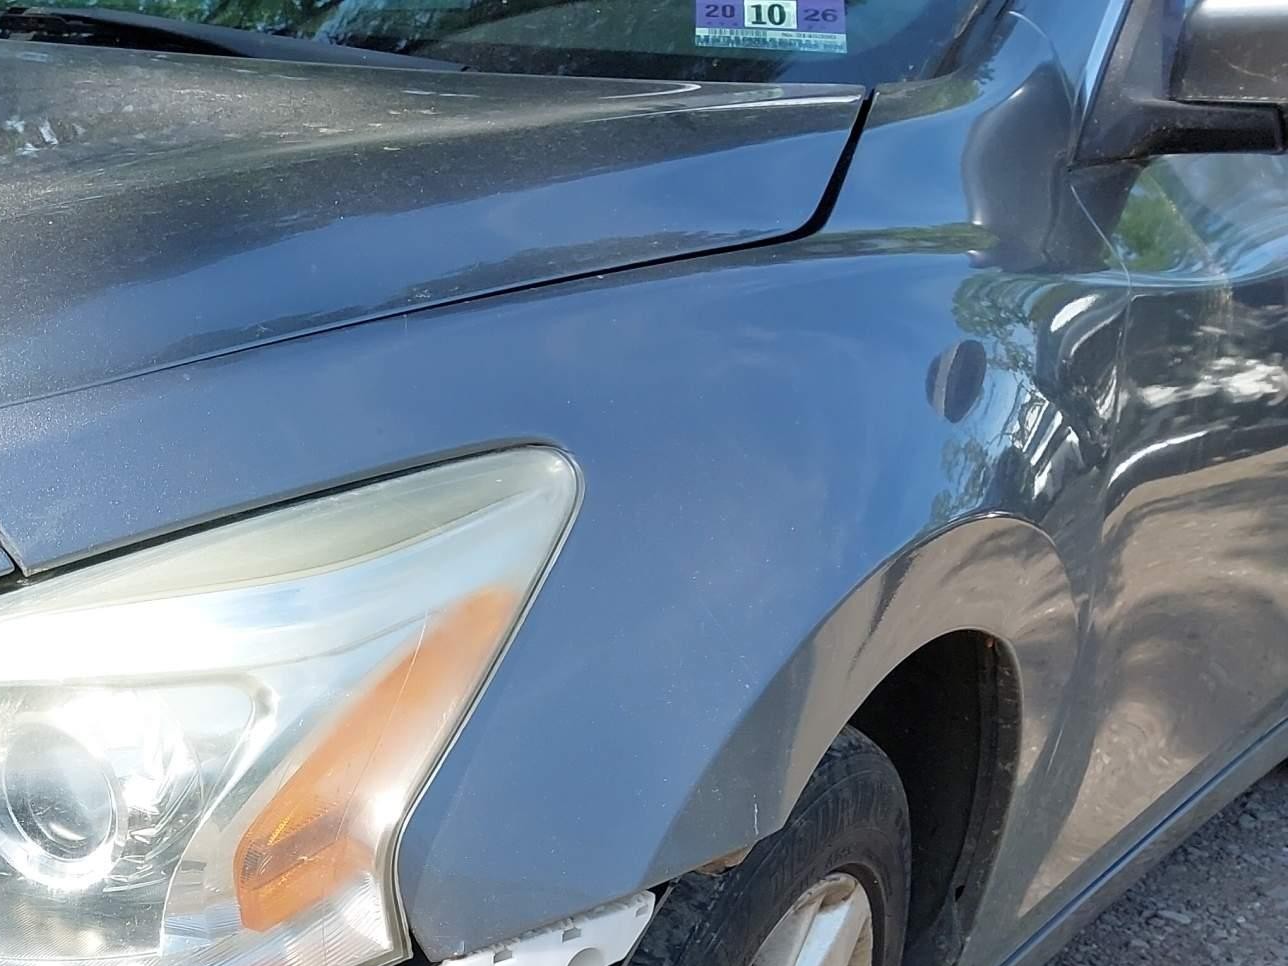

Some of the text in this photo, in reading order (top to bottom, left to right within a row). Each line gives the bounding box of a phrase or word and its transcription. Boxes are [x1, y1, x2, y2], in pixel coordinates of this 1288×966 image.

[704, 3, 838, 25] 20 10 26
